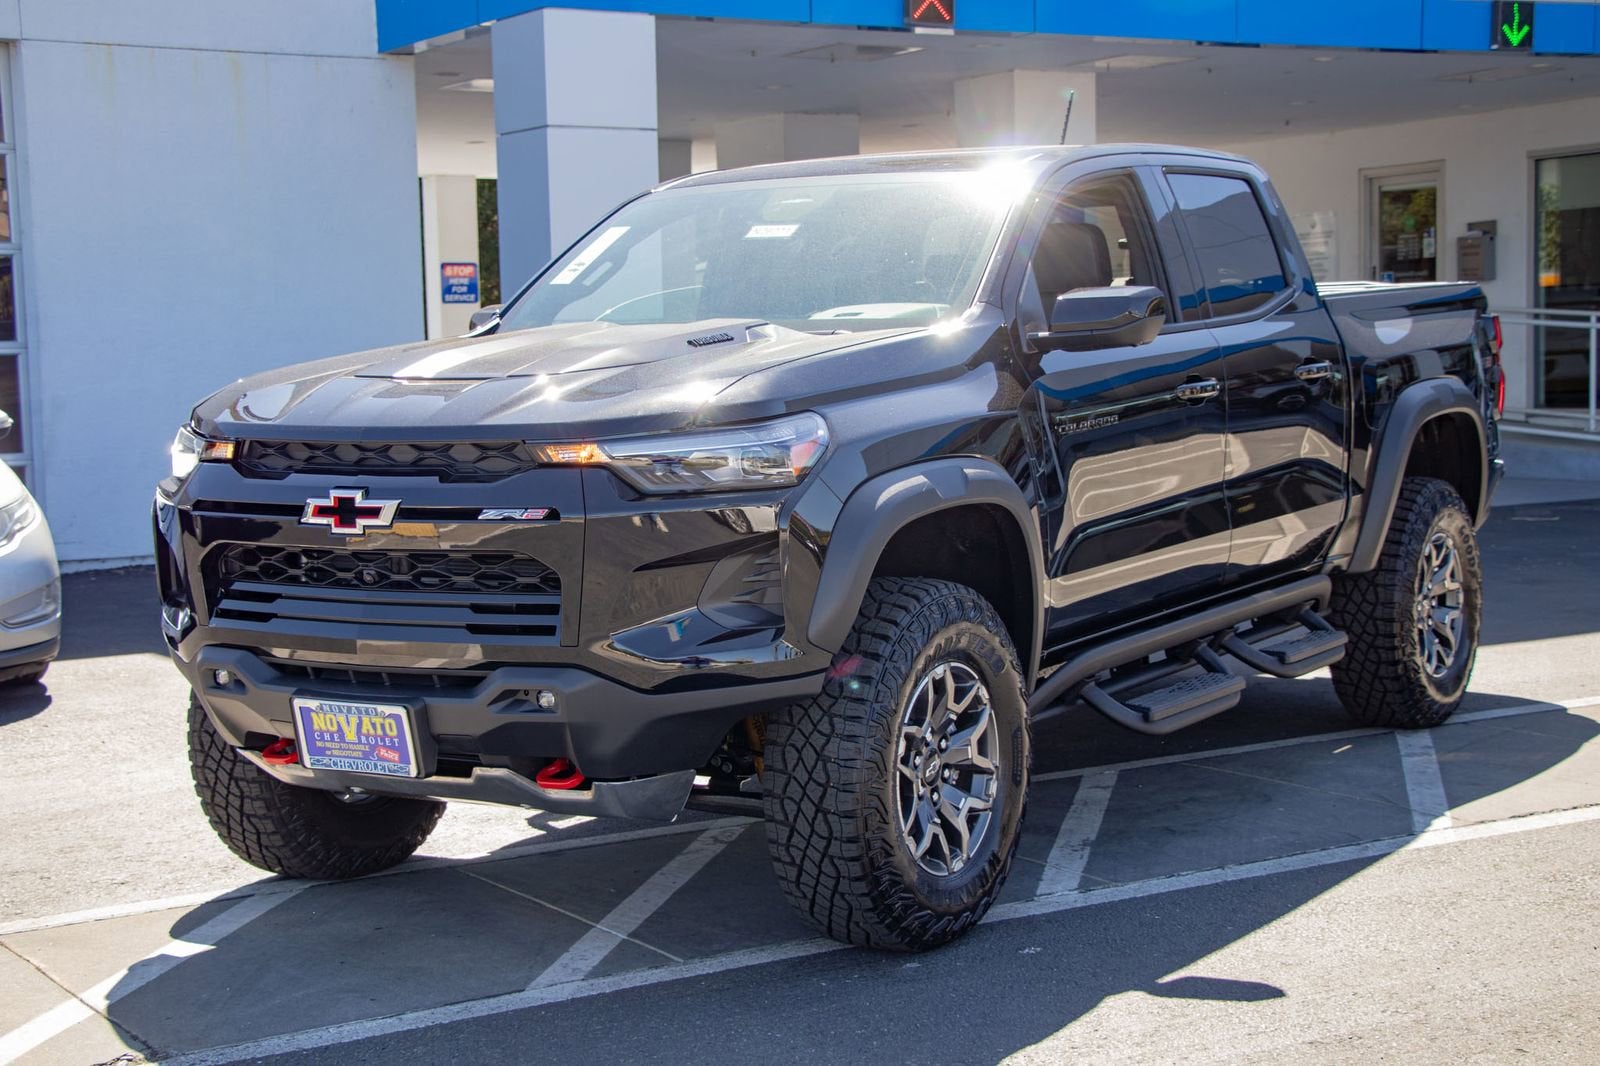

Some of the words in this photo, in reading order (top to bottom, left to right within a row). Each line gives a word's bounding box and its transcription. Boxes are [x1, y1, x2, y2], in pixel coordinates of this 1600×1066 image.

[445, 265, 474, 277] STOP
[478, 508, 548, 520] ZR2
[322, 704, 376, 715] NOVATO
[311, 711, 398, 742] NOVATO
[329, 759, 389, 774] CHEVROLET
